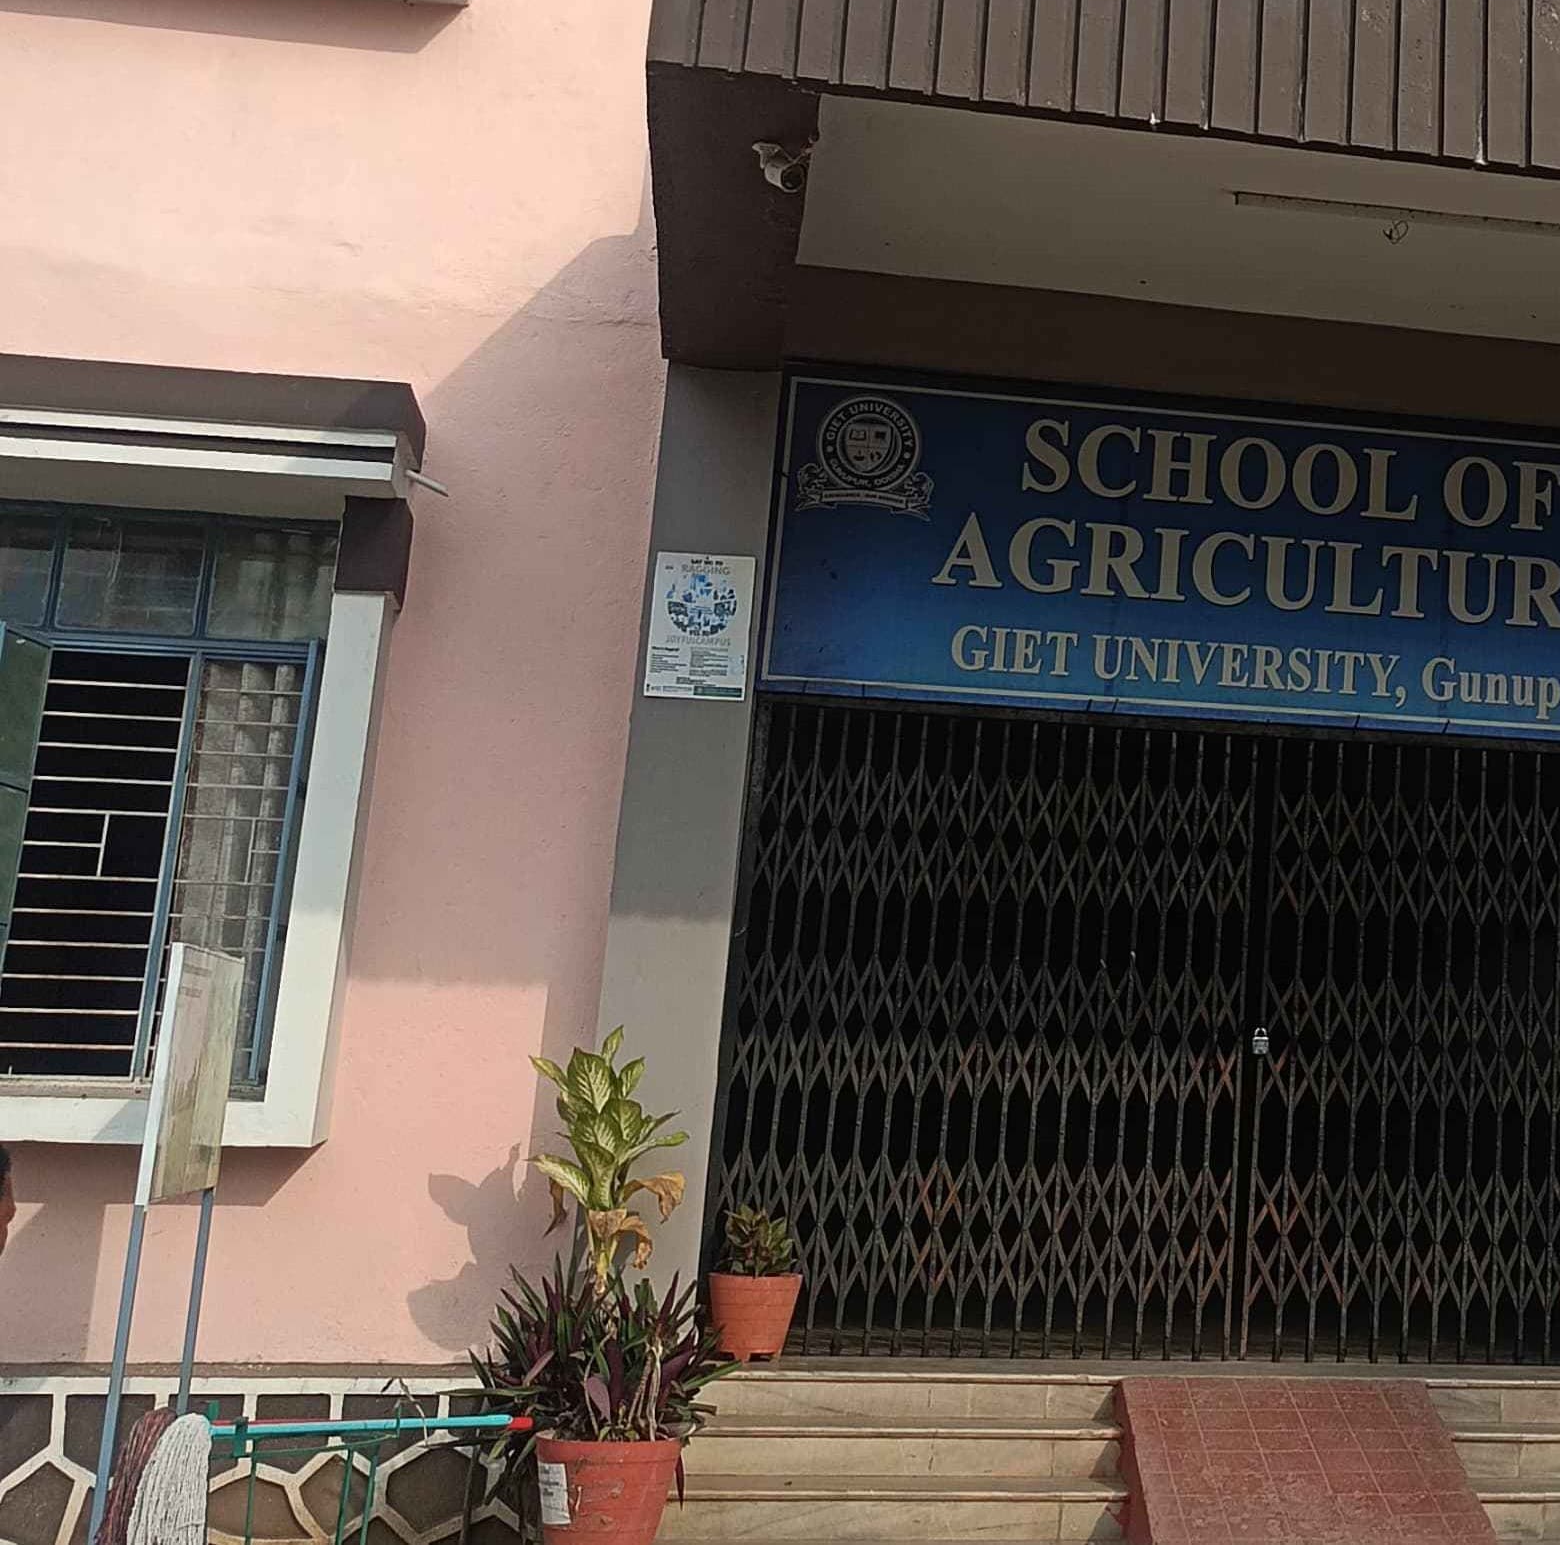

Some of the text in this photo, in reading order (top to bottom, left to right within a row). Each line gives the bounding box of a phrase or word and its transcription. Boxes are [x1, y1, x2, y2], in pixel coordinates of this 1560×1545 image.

[848, 402, 914, 448] UNIVERSITY
[1020, 418, 1419, 522] SCHOOL
[680, 564, 731, 575] RAGGING
[950, 623, 1080, 680] GIET
[1092, 632, 1408, 709] UNIVERSITY,
